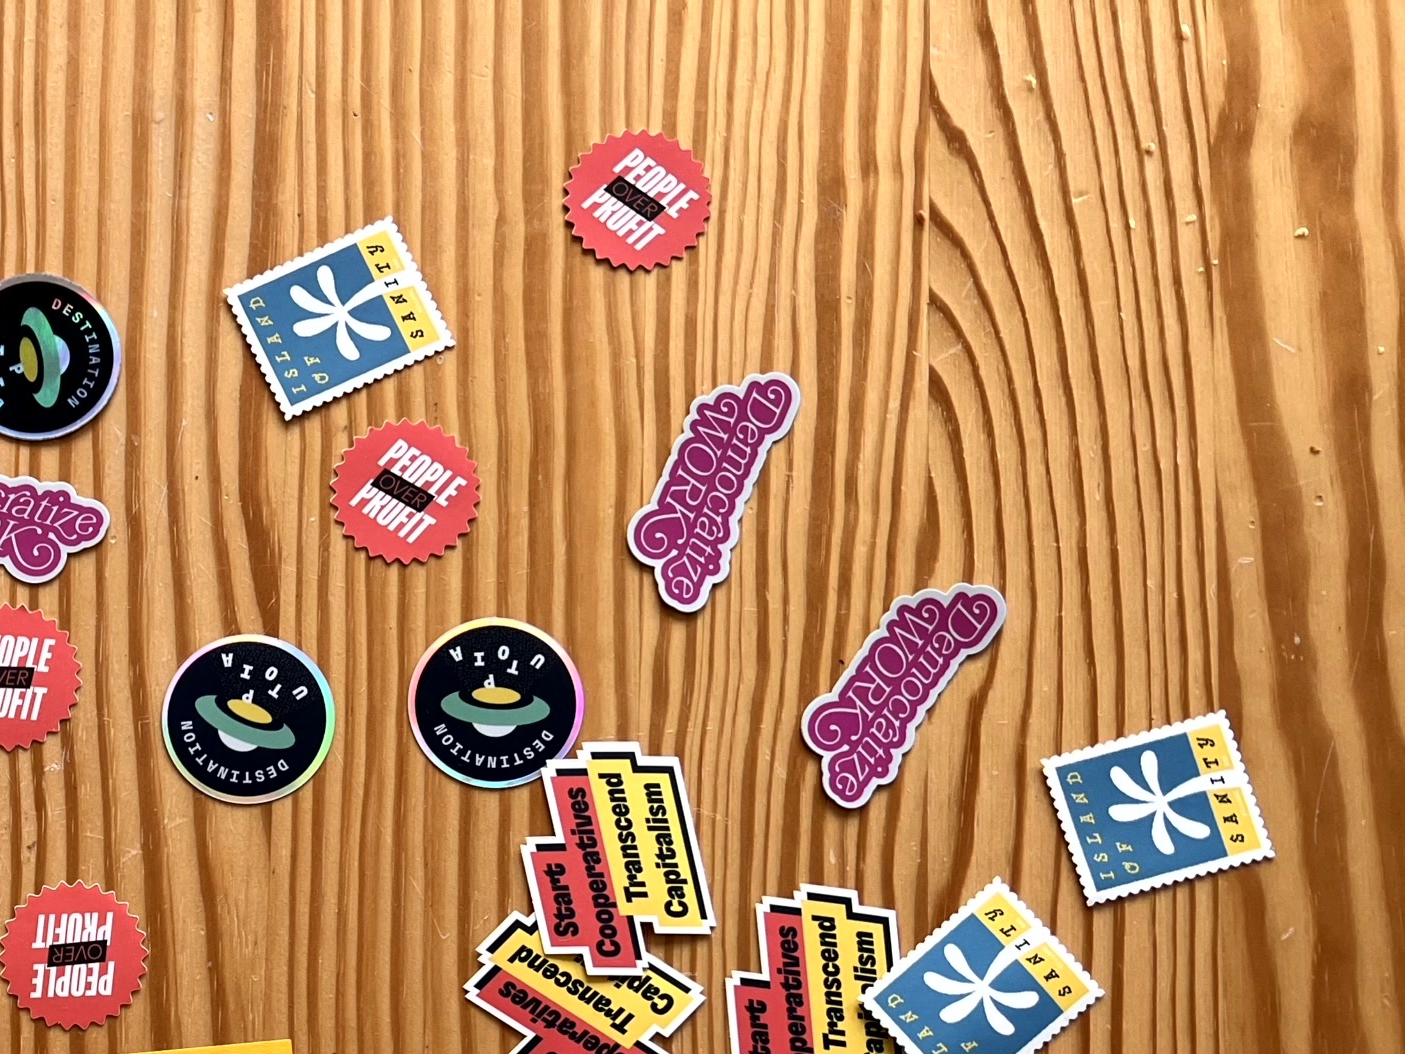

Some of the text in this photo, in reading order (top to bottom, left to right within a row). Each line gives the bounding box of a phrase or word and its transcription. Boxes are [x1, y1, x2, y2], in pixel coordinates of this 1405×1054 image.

[611, 147, 701, 220] PEOPLE
[612, 181, 660, 219] OVER
[366, 244, 424, 340] SANITY
[51, 298, 101, 409] DESTINATION
[248, 296, 307, 395] ISLAND
[303, 355, 330, 385] OF
[376, 437, 469, 508] PEOPLE
[379, 474, 429, 510] OVER
[639, 398, 738, 554] WORK
[667, 384, 786, 599] Democratize
[220, 652, 309, 706] UTOPIA
[448, 644, 546, 690] UTOPIA
[814, 604, 939, 745] WORK
[834, 598, 990, 796] Democratize
[180, 720, 290, 784] DESTINATION
[433, 723, 554, 769] DESTINATION
[1195, 737, 1245, 844] SANITY
[596, 772, 649, 904] Transcend
[642, 782, 689, 918] Capitalism
[1065, 771, 1115, 880] ISLAND
[1115, 841, 1140, 875] OF
[543, 862, 580, 938] Start
[566, 786, 622, 958] Cooperatives
[28, 959, 116, 1000] PEOPLE
[51, 942, 104, 965] OVER
[506, 944, 635, 1036] Transcend
[810, 914, 847, 1051] Transcend
[984, 908, 1073, 998] SANITY
